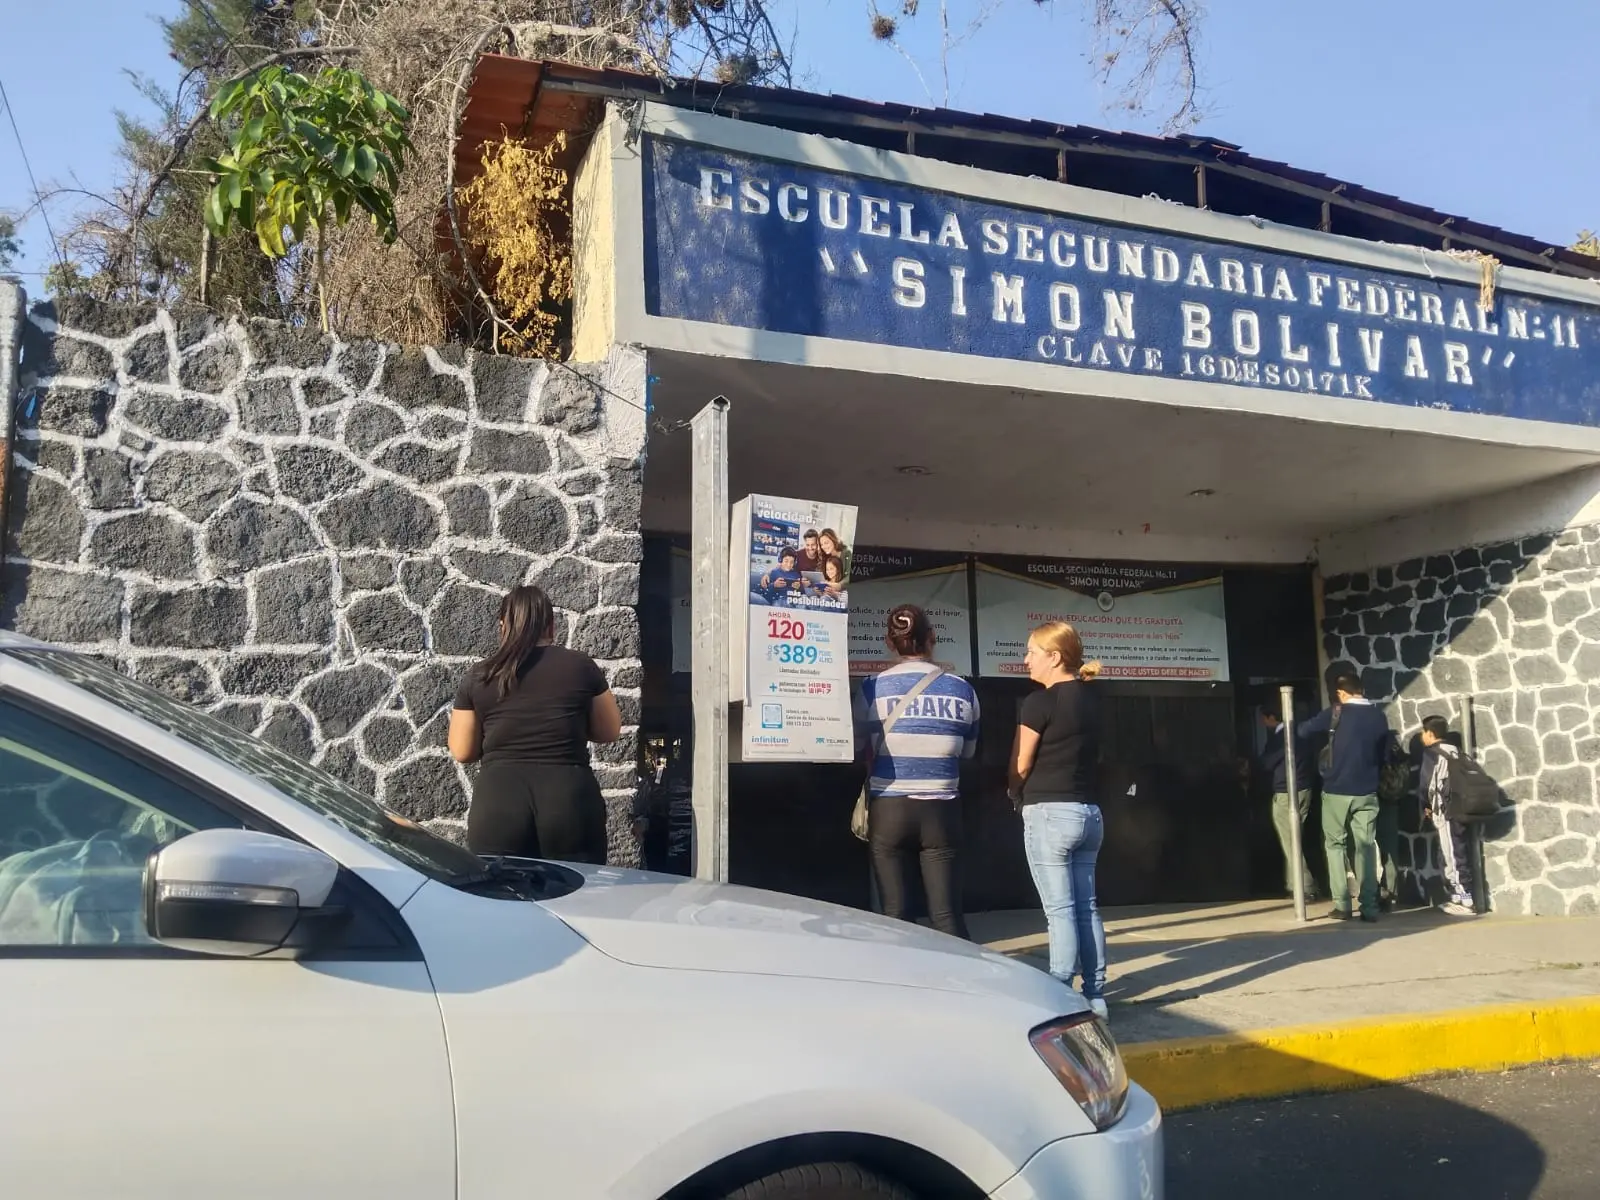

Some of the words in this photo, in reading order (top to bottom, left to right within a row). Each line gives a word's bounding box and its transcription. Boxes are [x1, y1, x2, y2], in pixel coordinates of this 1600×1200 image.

[700, 166, 968, 250] ESCUELA
[982, 219, 1297, 301] SECUNDARIA
[1307, 272, 1499, 336] FEDERAL
[1037, 334, 1163, 372] CLAVE
[1027, 563, 1065, 574] ESCUELA
[1066, 565, 1118, 576] SECUNDARIA
[1120, 568, 1154, 578] FEDERAL
[786, 596, 847, 610] posibilidades
[1027, 612, 1044, 622] HAY
[767, 619, 805, 641] 120
[1122, 668, 1137, 676] QUE
[1137, 668, 1160, 676] USTED
[751, 735, 790, 743] infinitum
